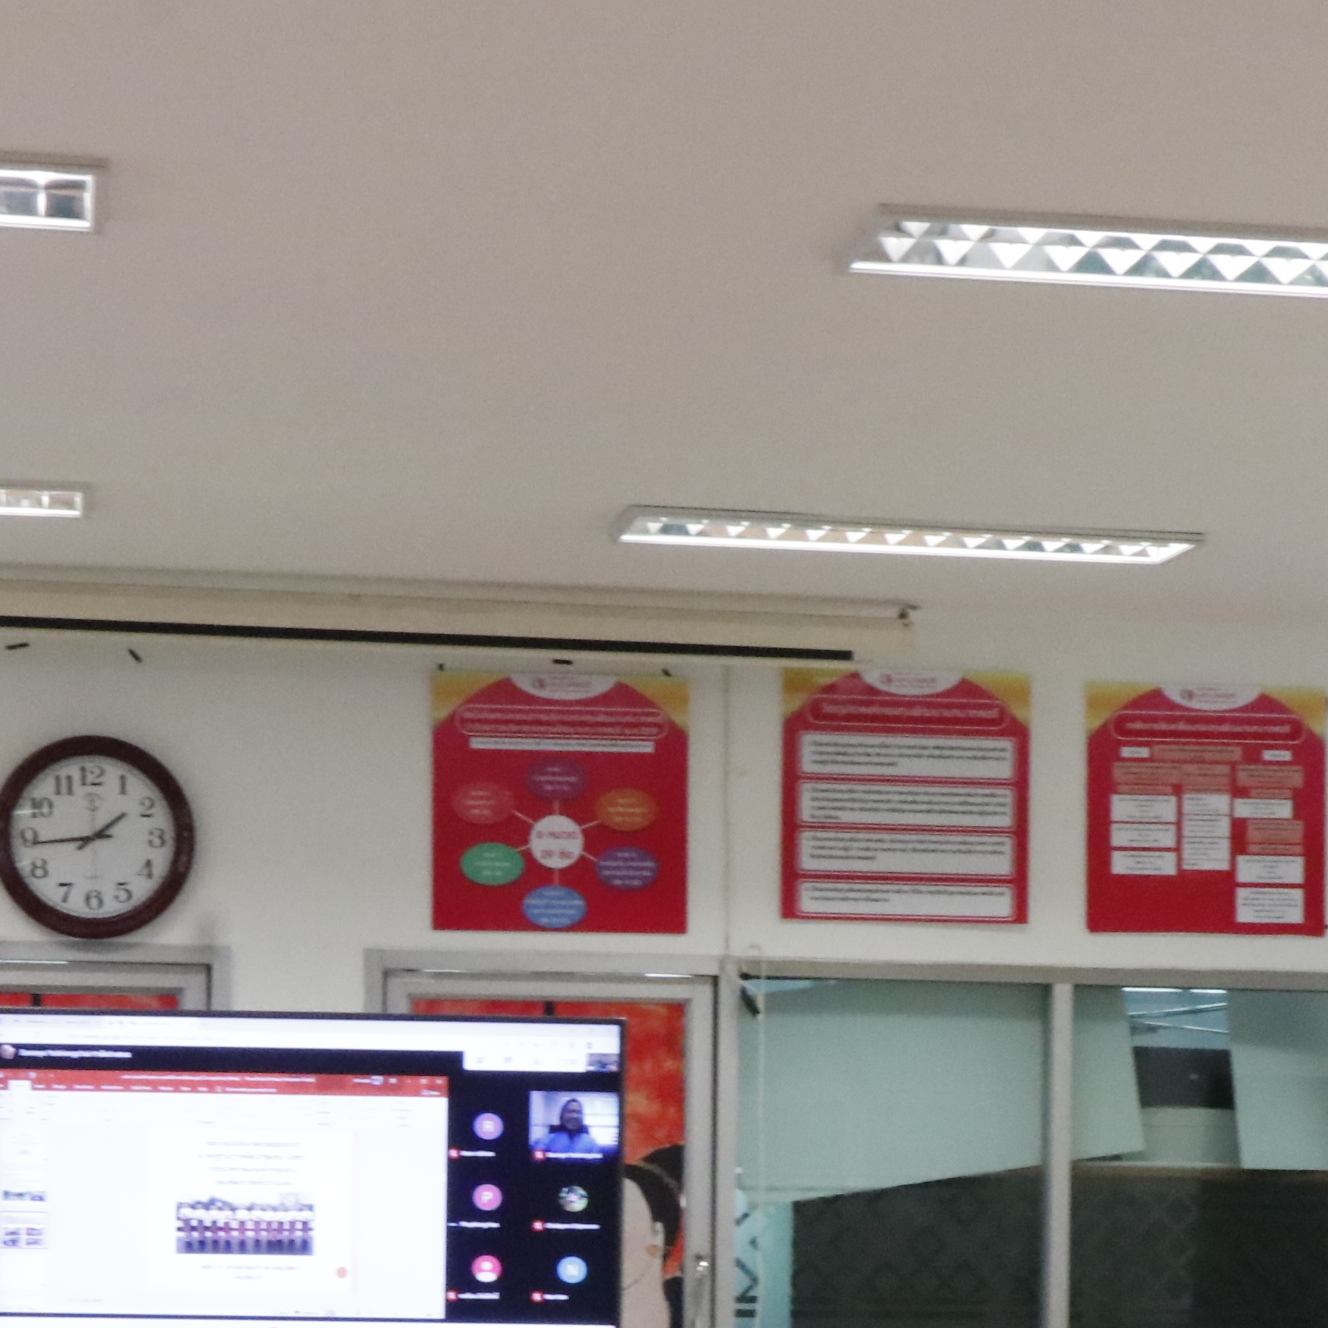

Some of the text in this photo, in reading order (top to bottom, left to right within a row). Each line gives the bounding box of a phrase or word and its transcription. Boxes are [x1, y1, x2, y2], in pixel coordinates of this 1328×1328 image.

[53, 774, 74, 796] 11
[79, 765, 105, 786] 12
[119, 774, 128, 795] 1
[30, 797, 54, 818] 10
[139, 797, 156, 818] 2
[148, 827, 166, 848] 3
[30, 858, 49, 879] 8
[137, 858, 154, 879] 4
[58, 882, 74, 903] 7
[84, 889, 104, 910] 6
[113, 882, 133, 903] 5
